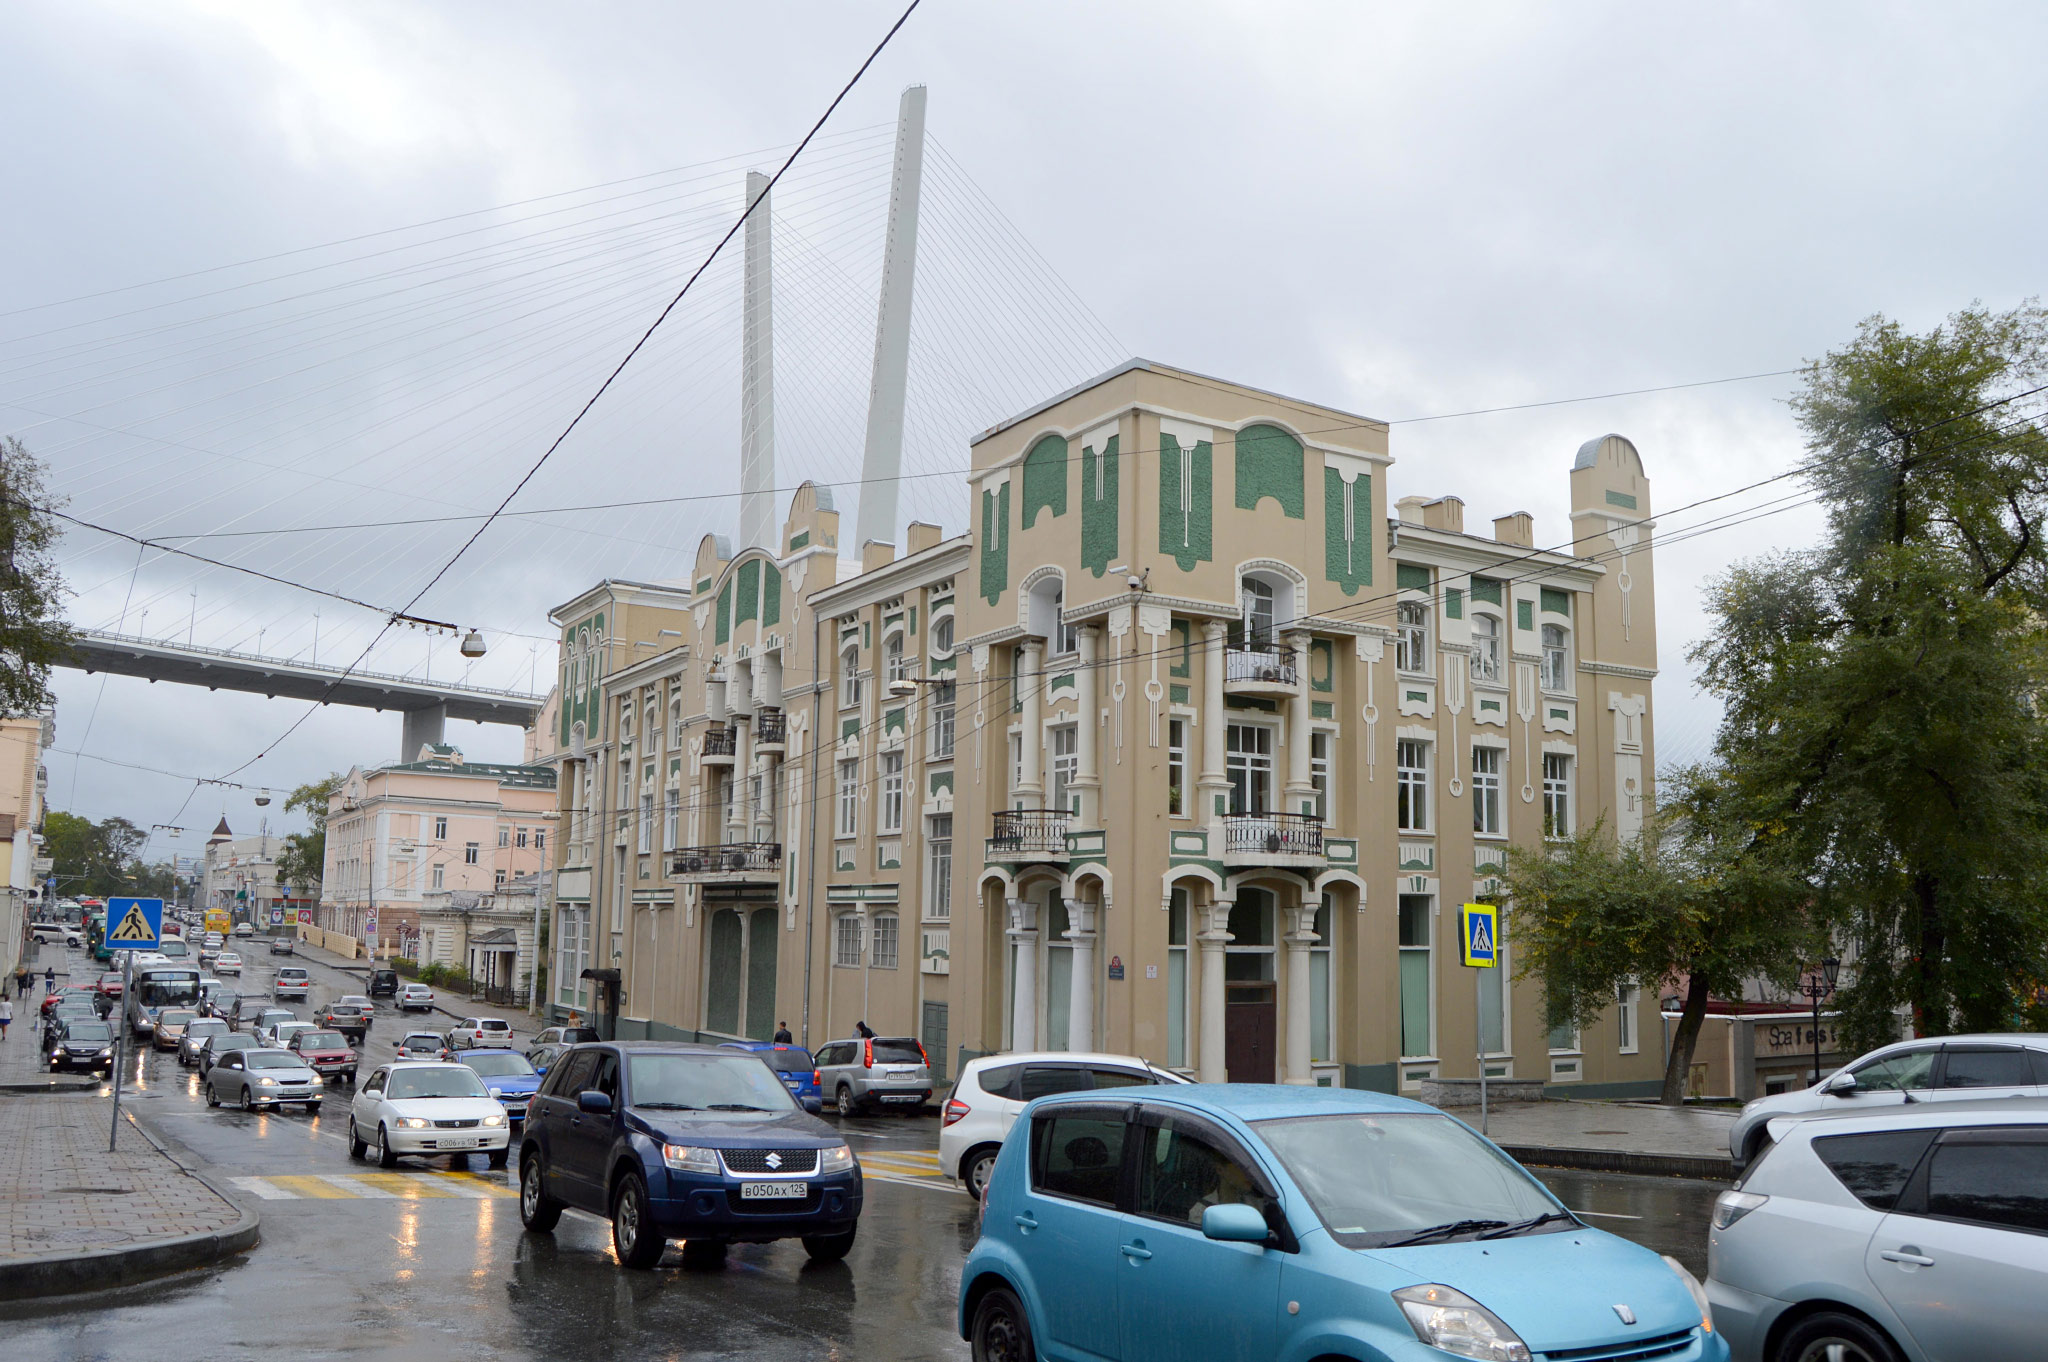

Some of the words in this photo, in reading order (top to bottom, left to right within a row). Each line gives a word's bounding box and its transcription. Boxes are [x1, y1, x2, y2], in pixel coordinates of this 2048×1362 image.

[1769, 1026, 1792, 1050] Spa
[745, 1185, 787, 1196] В050АХ
[789, 1184, 805, 1193] 125
